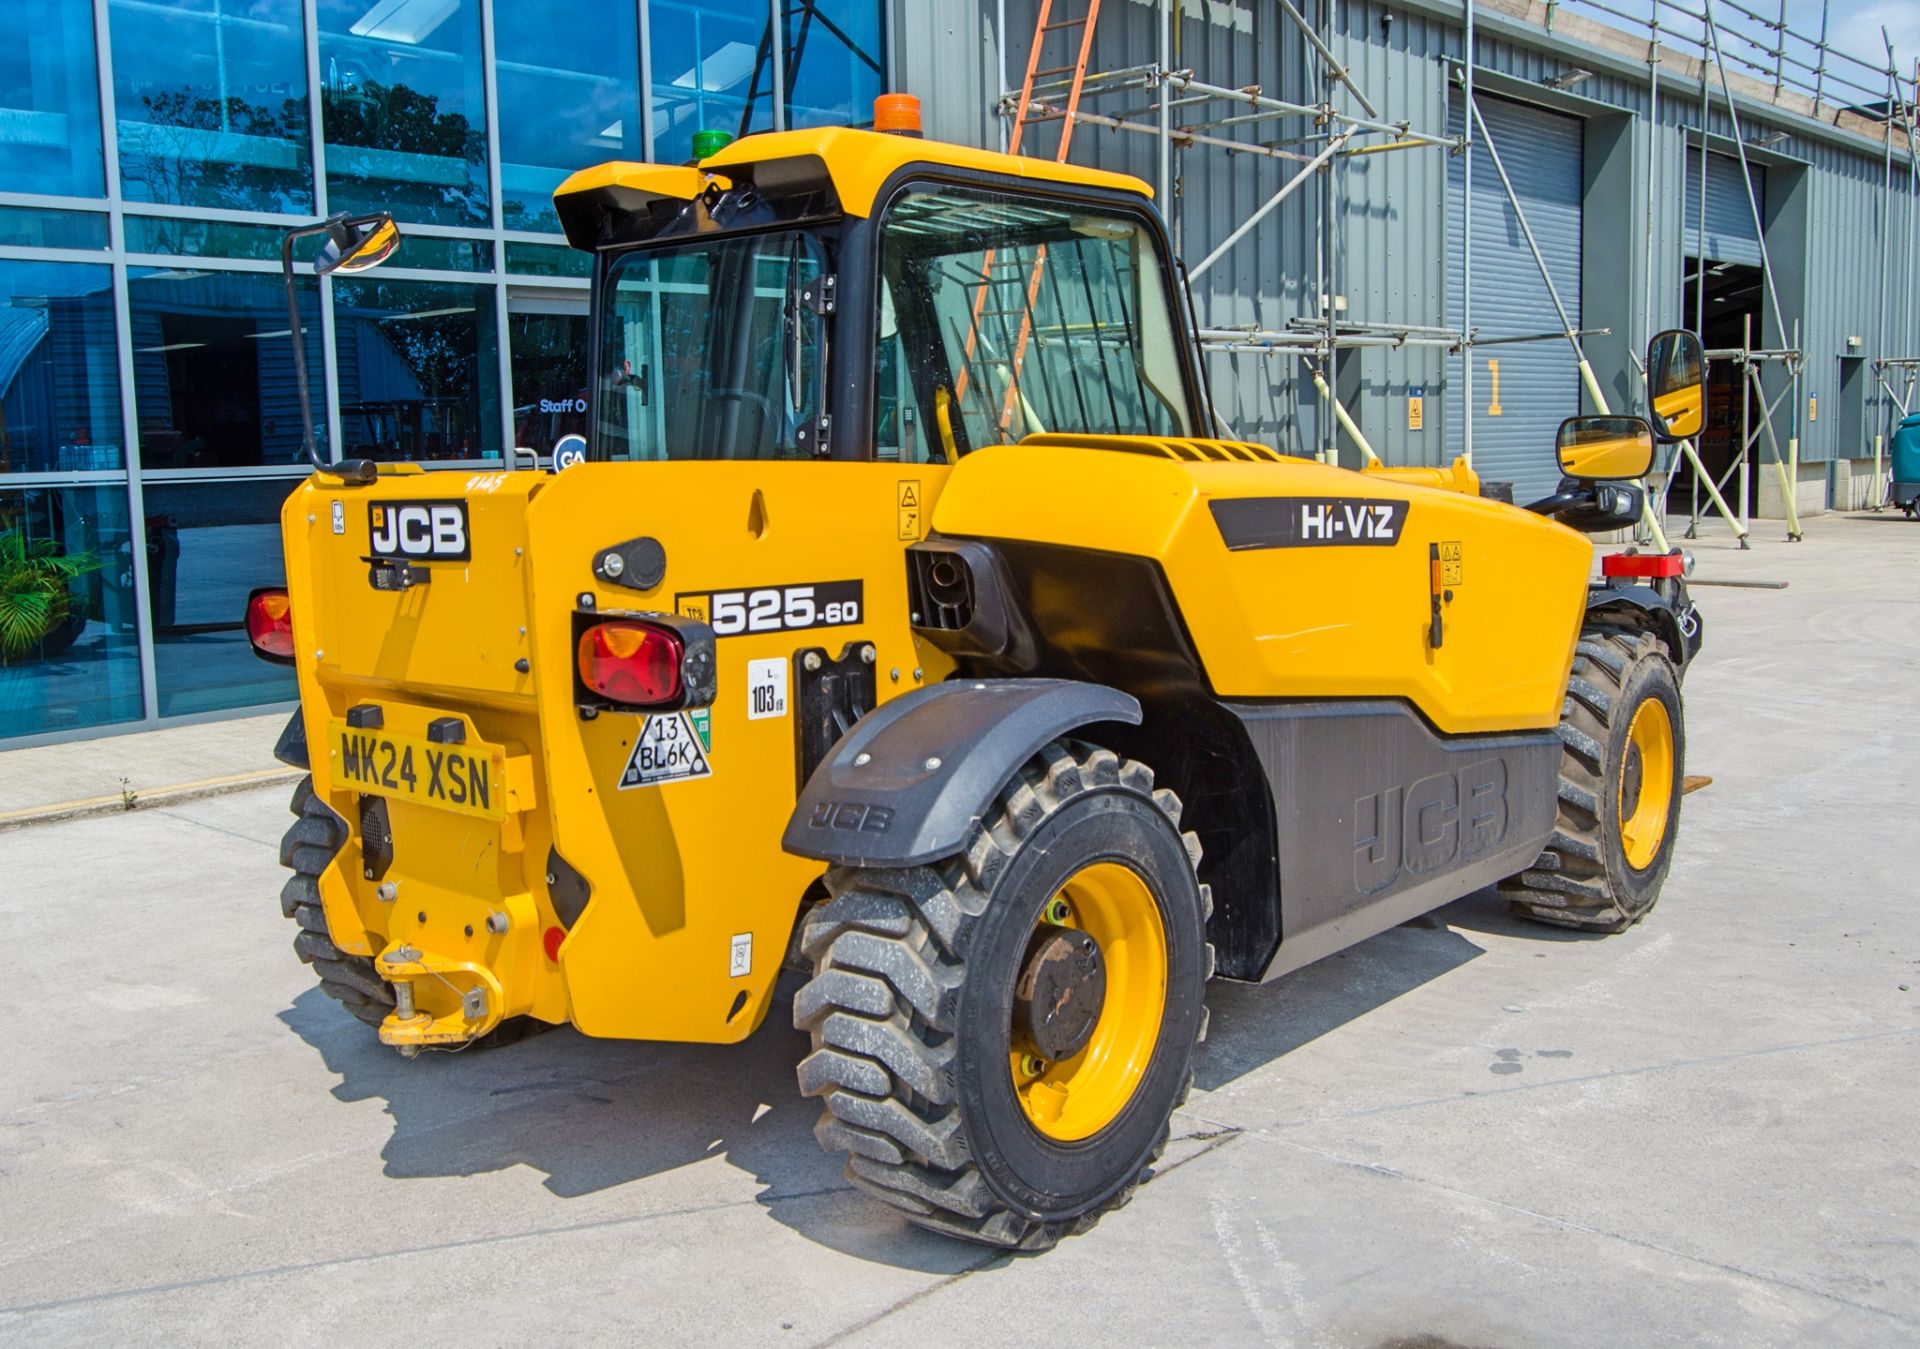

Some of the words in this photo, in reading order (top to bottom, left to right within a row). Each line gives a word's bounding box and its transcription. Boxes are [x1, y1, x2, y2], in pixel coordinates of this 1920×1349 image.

[540, 399, 574, 413] Staff
[575, 399, 587, 413] O
[372, 506, 466, 554] JCB
[752, 684, 775, 714] 103
[655, 717, 678, 742] 13
[641, 741, 690, 770] BL6K
[341, 733, 417, 792] MK24
[426, 749, 490, 810] XSN
[808, 802, 896, 833] JCB
[1354, 758, 1509, 894] JCB
